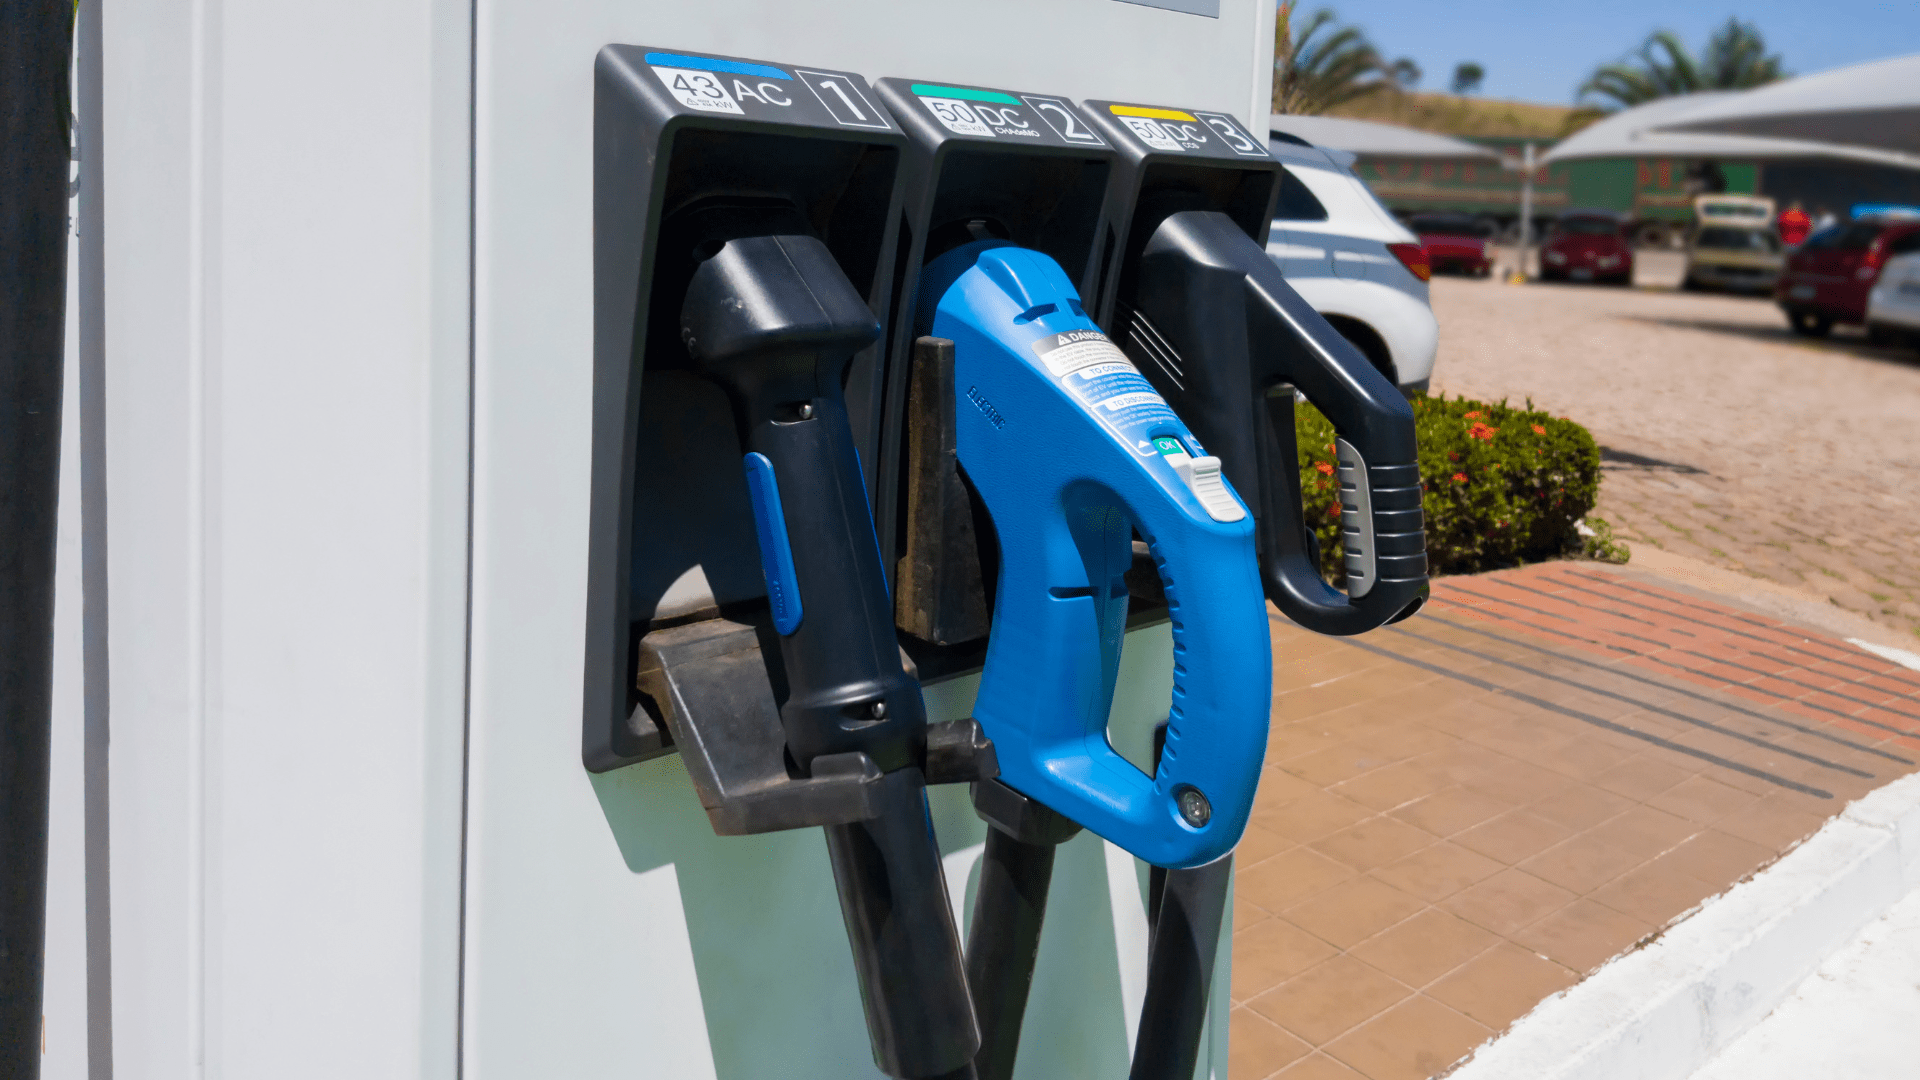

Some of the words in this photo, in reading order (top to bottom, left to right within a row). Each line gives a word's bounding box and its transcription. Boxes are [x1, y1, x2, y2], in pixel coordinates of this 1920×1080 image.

[673, 73, 724, 99] 43
[733, 79, 792, 106] AC
[820, 81, 868, 121] 1
[931, 102, 976, 124] 50
[974, 105, 1029, 128] DC
[1039, 103, 1094, 140] 2
[1129, 121, 1167, 140] 50
[1161, 123, 1207, 143] DC
[1209, 118, 1254, 151] 3
[1089, 367, 1103, 375] TO
[966, 385, 1006, 431] ELECTRIC
[1112, 399, 1125, 407] TO
[1158, 440, 1177, 450] OK
